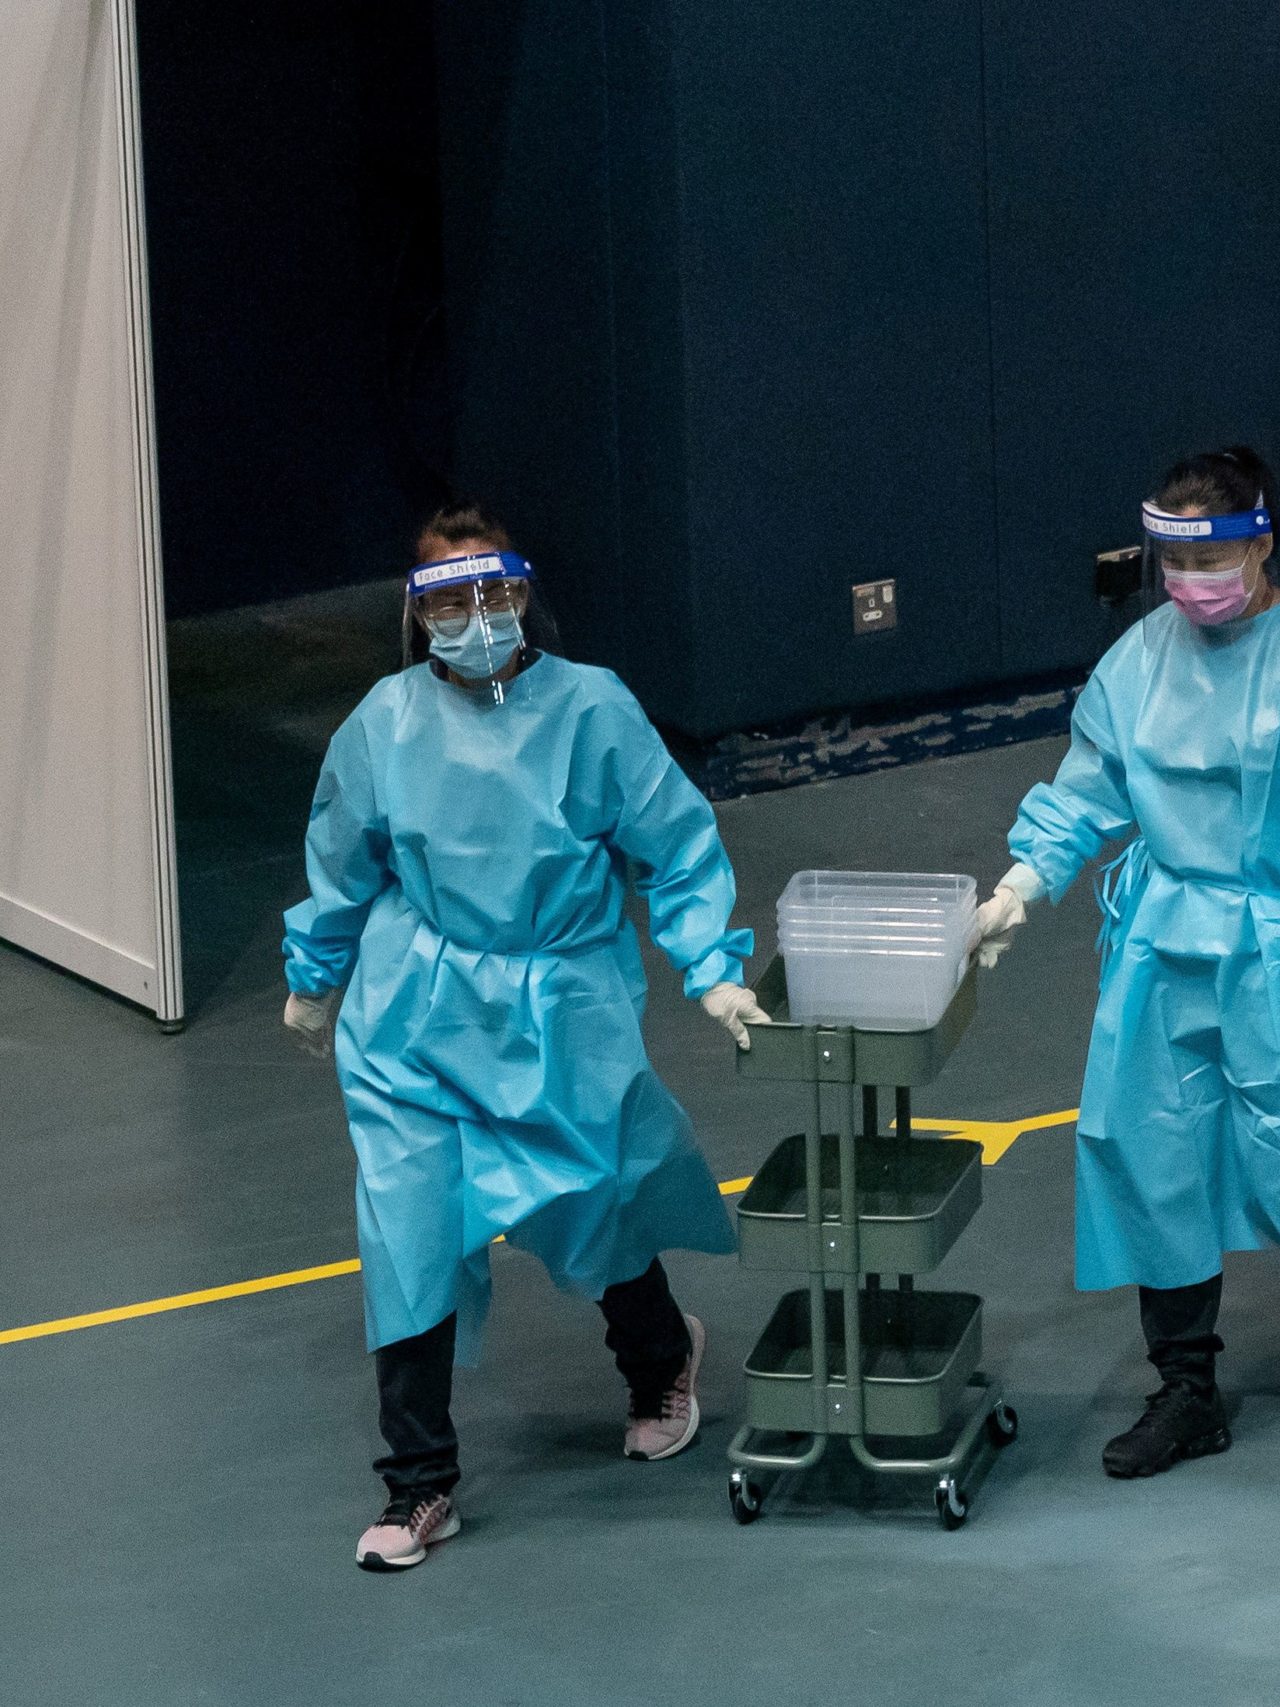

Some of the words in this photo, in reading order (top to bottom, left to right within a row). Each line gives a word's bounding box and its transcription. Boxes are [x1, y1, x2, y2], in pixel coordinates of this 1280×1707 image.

[1162, 522, 1200, 534] Shield
[418, 569, 443, 582] Face
[449, 559, 490, 575] Shield
